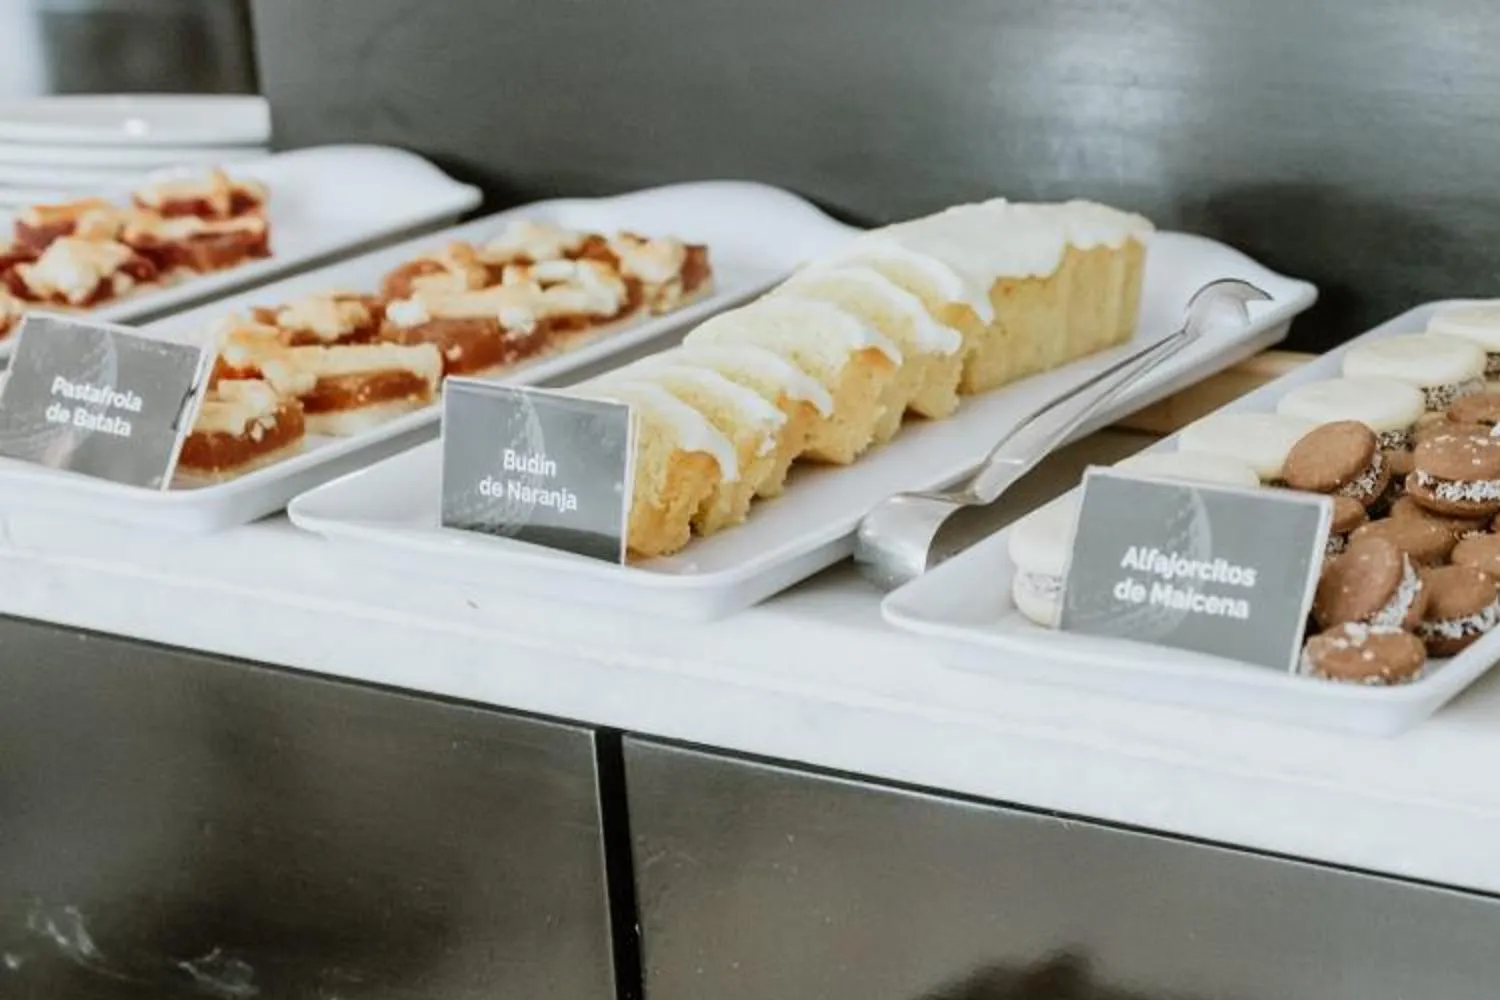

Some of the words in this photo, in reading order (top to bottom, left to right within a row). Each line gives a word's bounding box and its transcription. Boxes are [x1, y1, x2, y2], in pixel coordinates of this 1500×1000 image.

[51, 375, 143, 413] Pastafrola
[45, 402, 70, 423] de
[73, 407, 132, 437] Batata
[479, 475, 503, 498] de
[507, 480, 577, 513] Naranja
[1120, 545, 1258, 588] Alfajorcitos
[1113, 577, 1147, 603] de
[1150, 581, 1249, 619] Maicena
